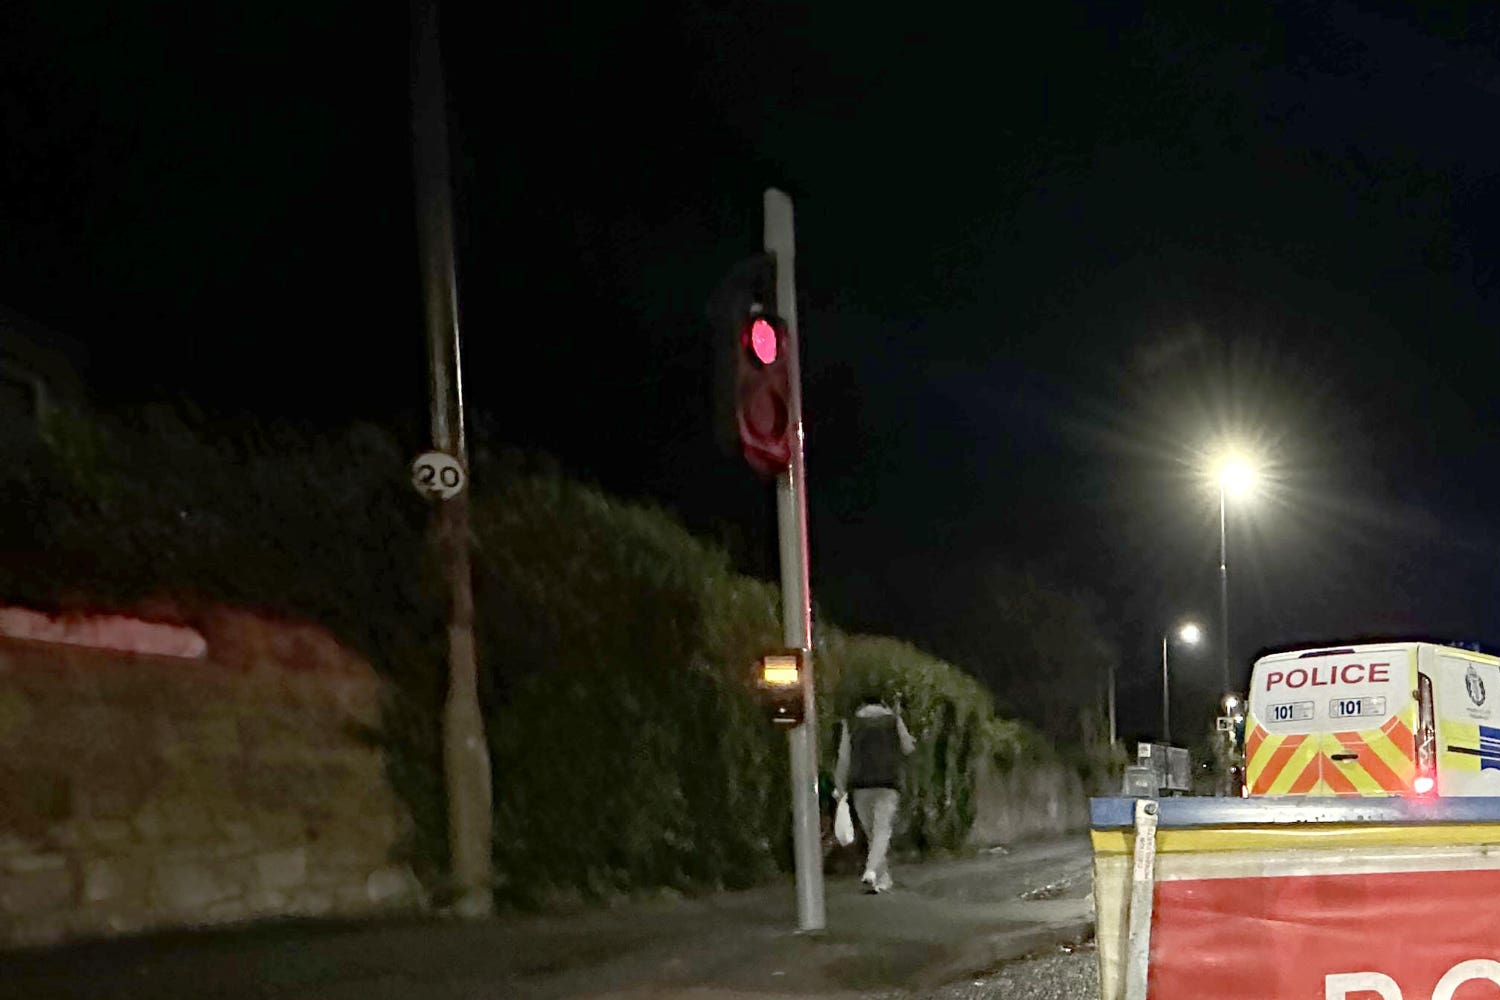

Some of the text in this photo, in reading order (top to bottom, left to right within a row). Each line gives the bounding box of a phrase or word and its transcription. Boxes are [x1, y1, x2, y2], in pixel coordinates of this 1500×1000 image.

[417, 464, 459, 488] 20
[1266, 663, 1390, 692] POLICE
[1274, 705, 1294, 720] 101
[1340, 700, 1361, 715] 101
